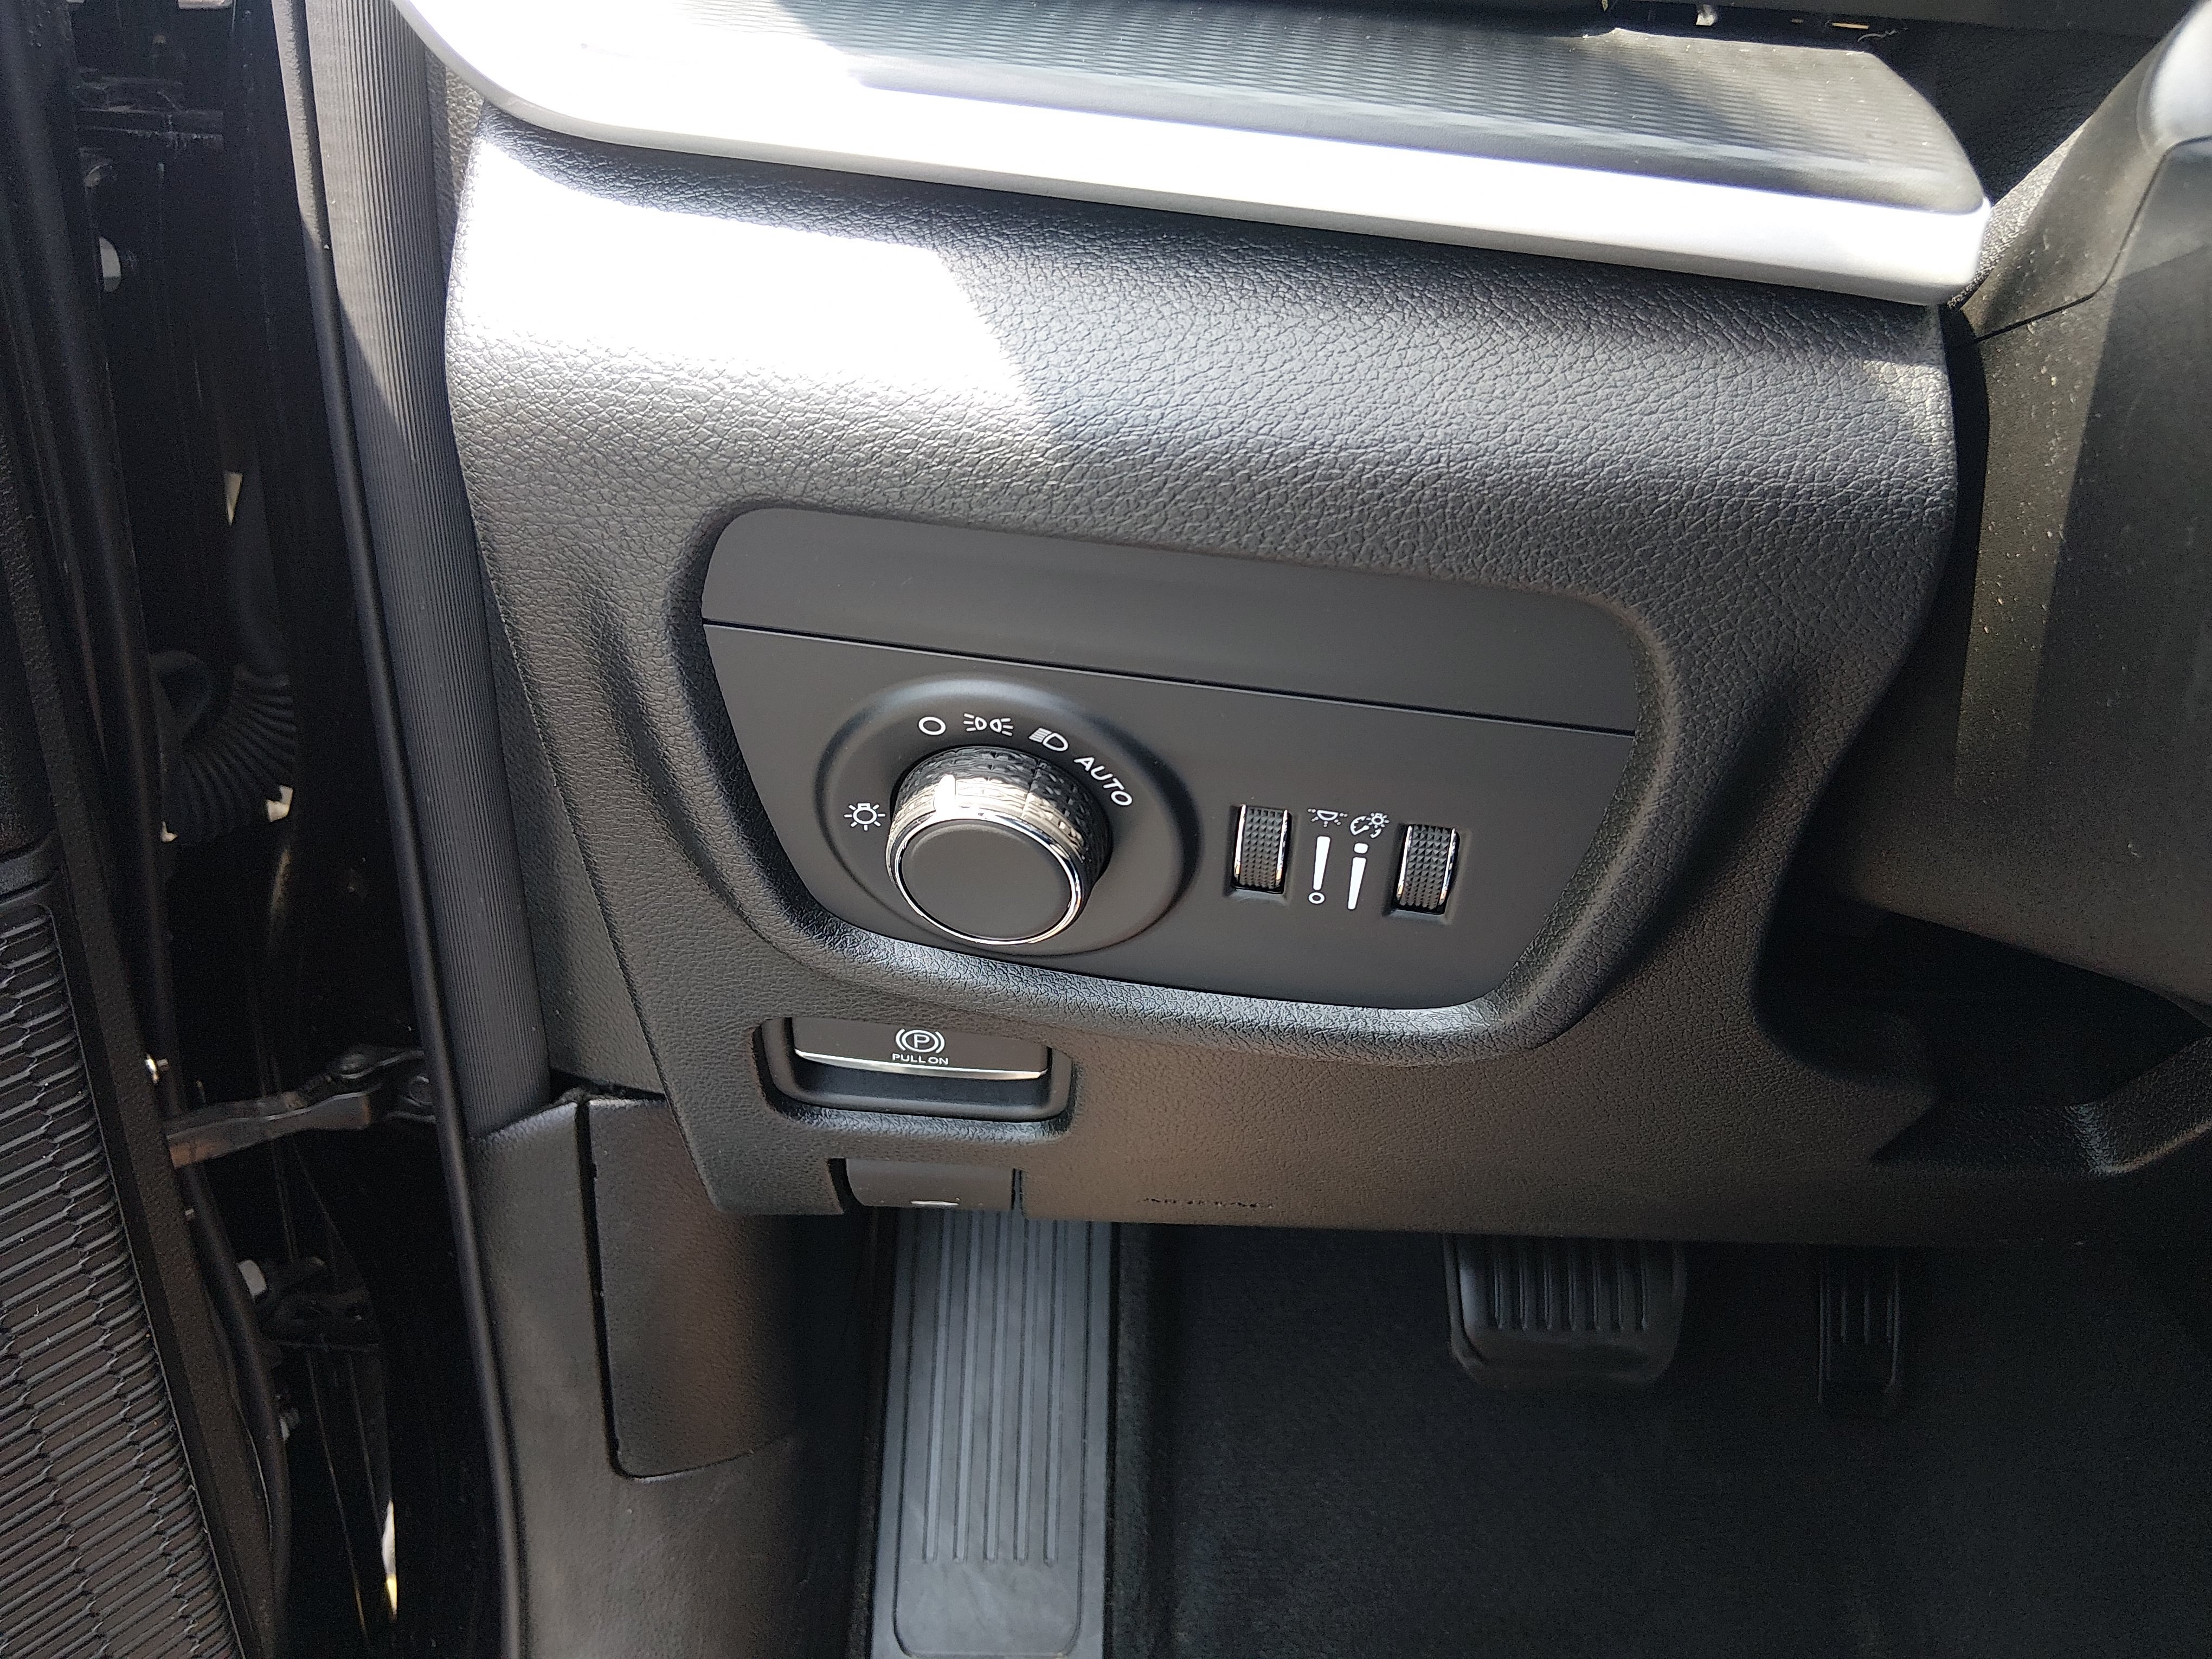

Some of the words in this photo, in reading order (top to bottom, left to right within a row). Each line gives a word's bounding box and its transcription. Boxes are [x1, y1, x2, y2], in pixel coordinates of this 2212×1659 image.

[1073, 757, 1132, 806] AUTO
[914, 1034, 930, 1049] P
[892, 1053, 927, 1063] PULL
[928, 1057, 949, 1065] ON
